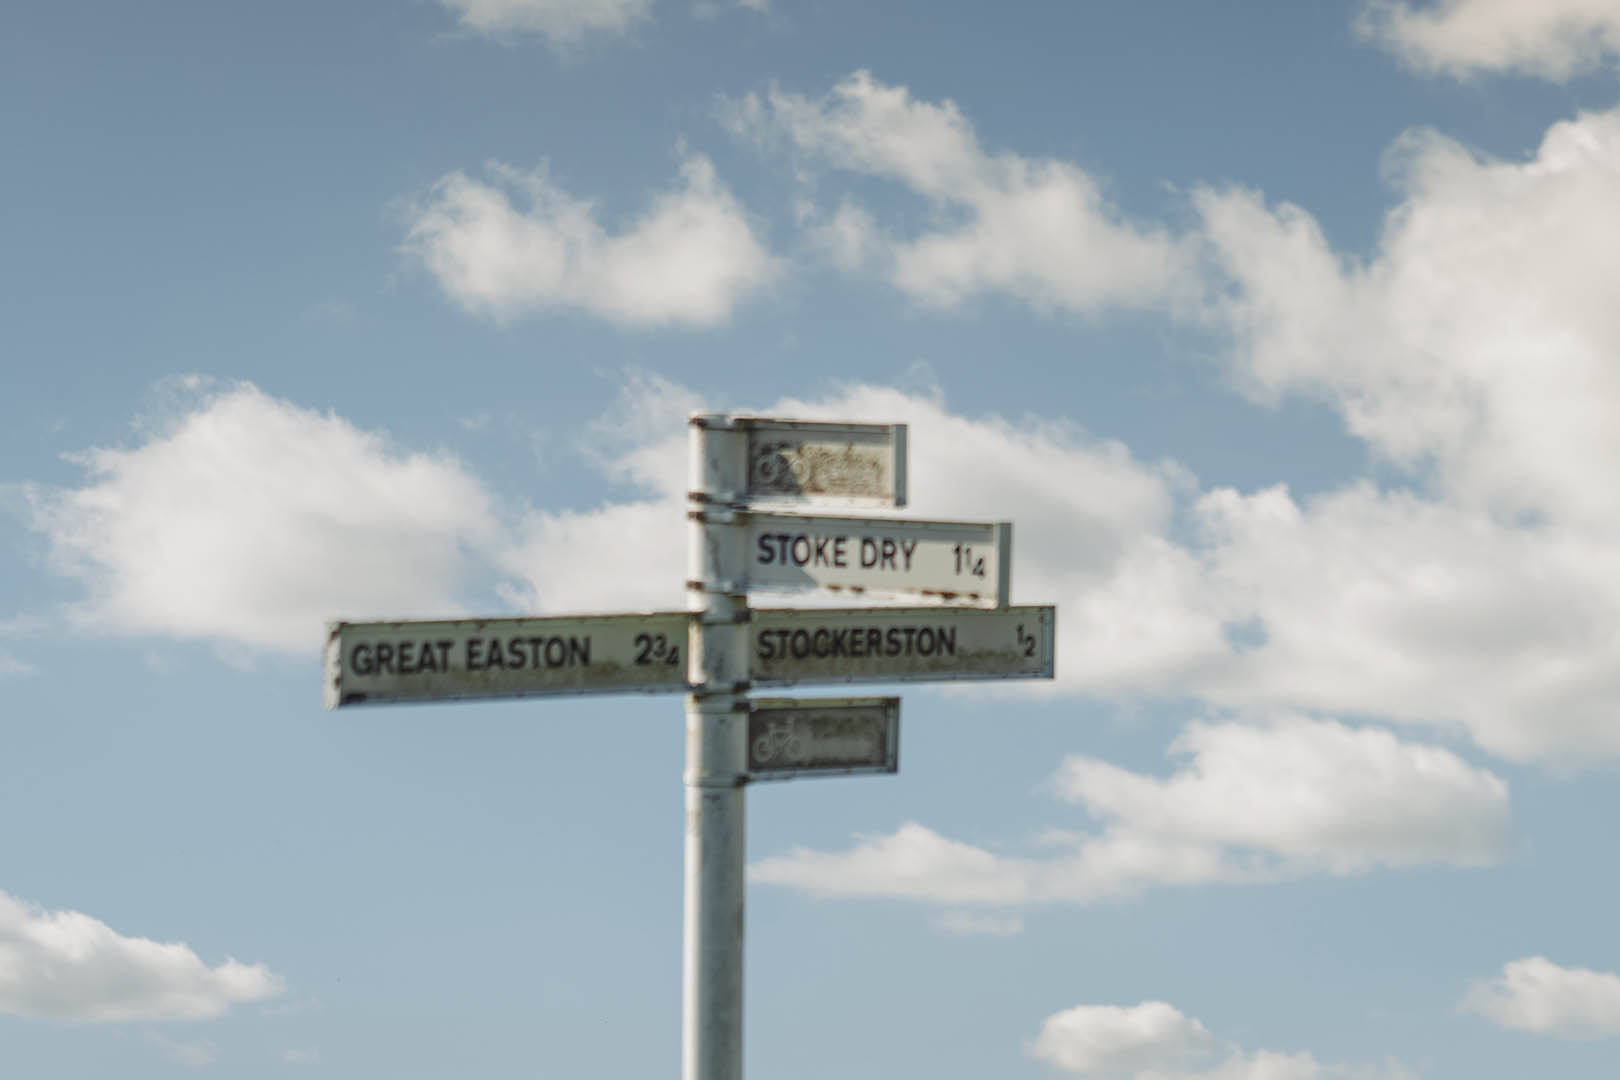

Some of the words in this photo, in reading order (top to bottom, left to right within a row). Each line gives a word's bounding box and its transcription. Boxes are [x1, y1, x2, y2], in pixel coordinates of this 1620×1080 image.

[757, 532, 848, 567] STOKE
[860, 538, 917, 572] DRY
[350, 639, 455, 676] GREAT
[465, 636, 592, 671] EASTON
[757, 625, 957, 660] STOCKERSTON
